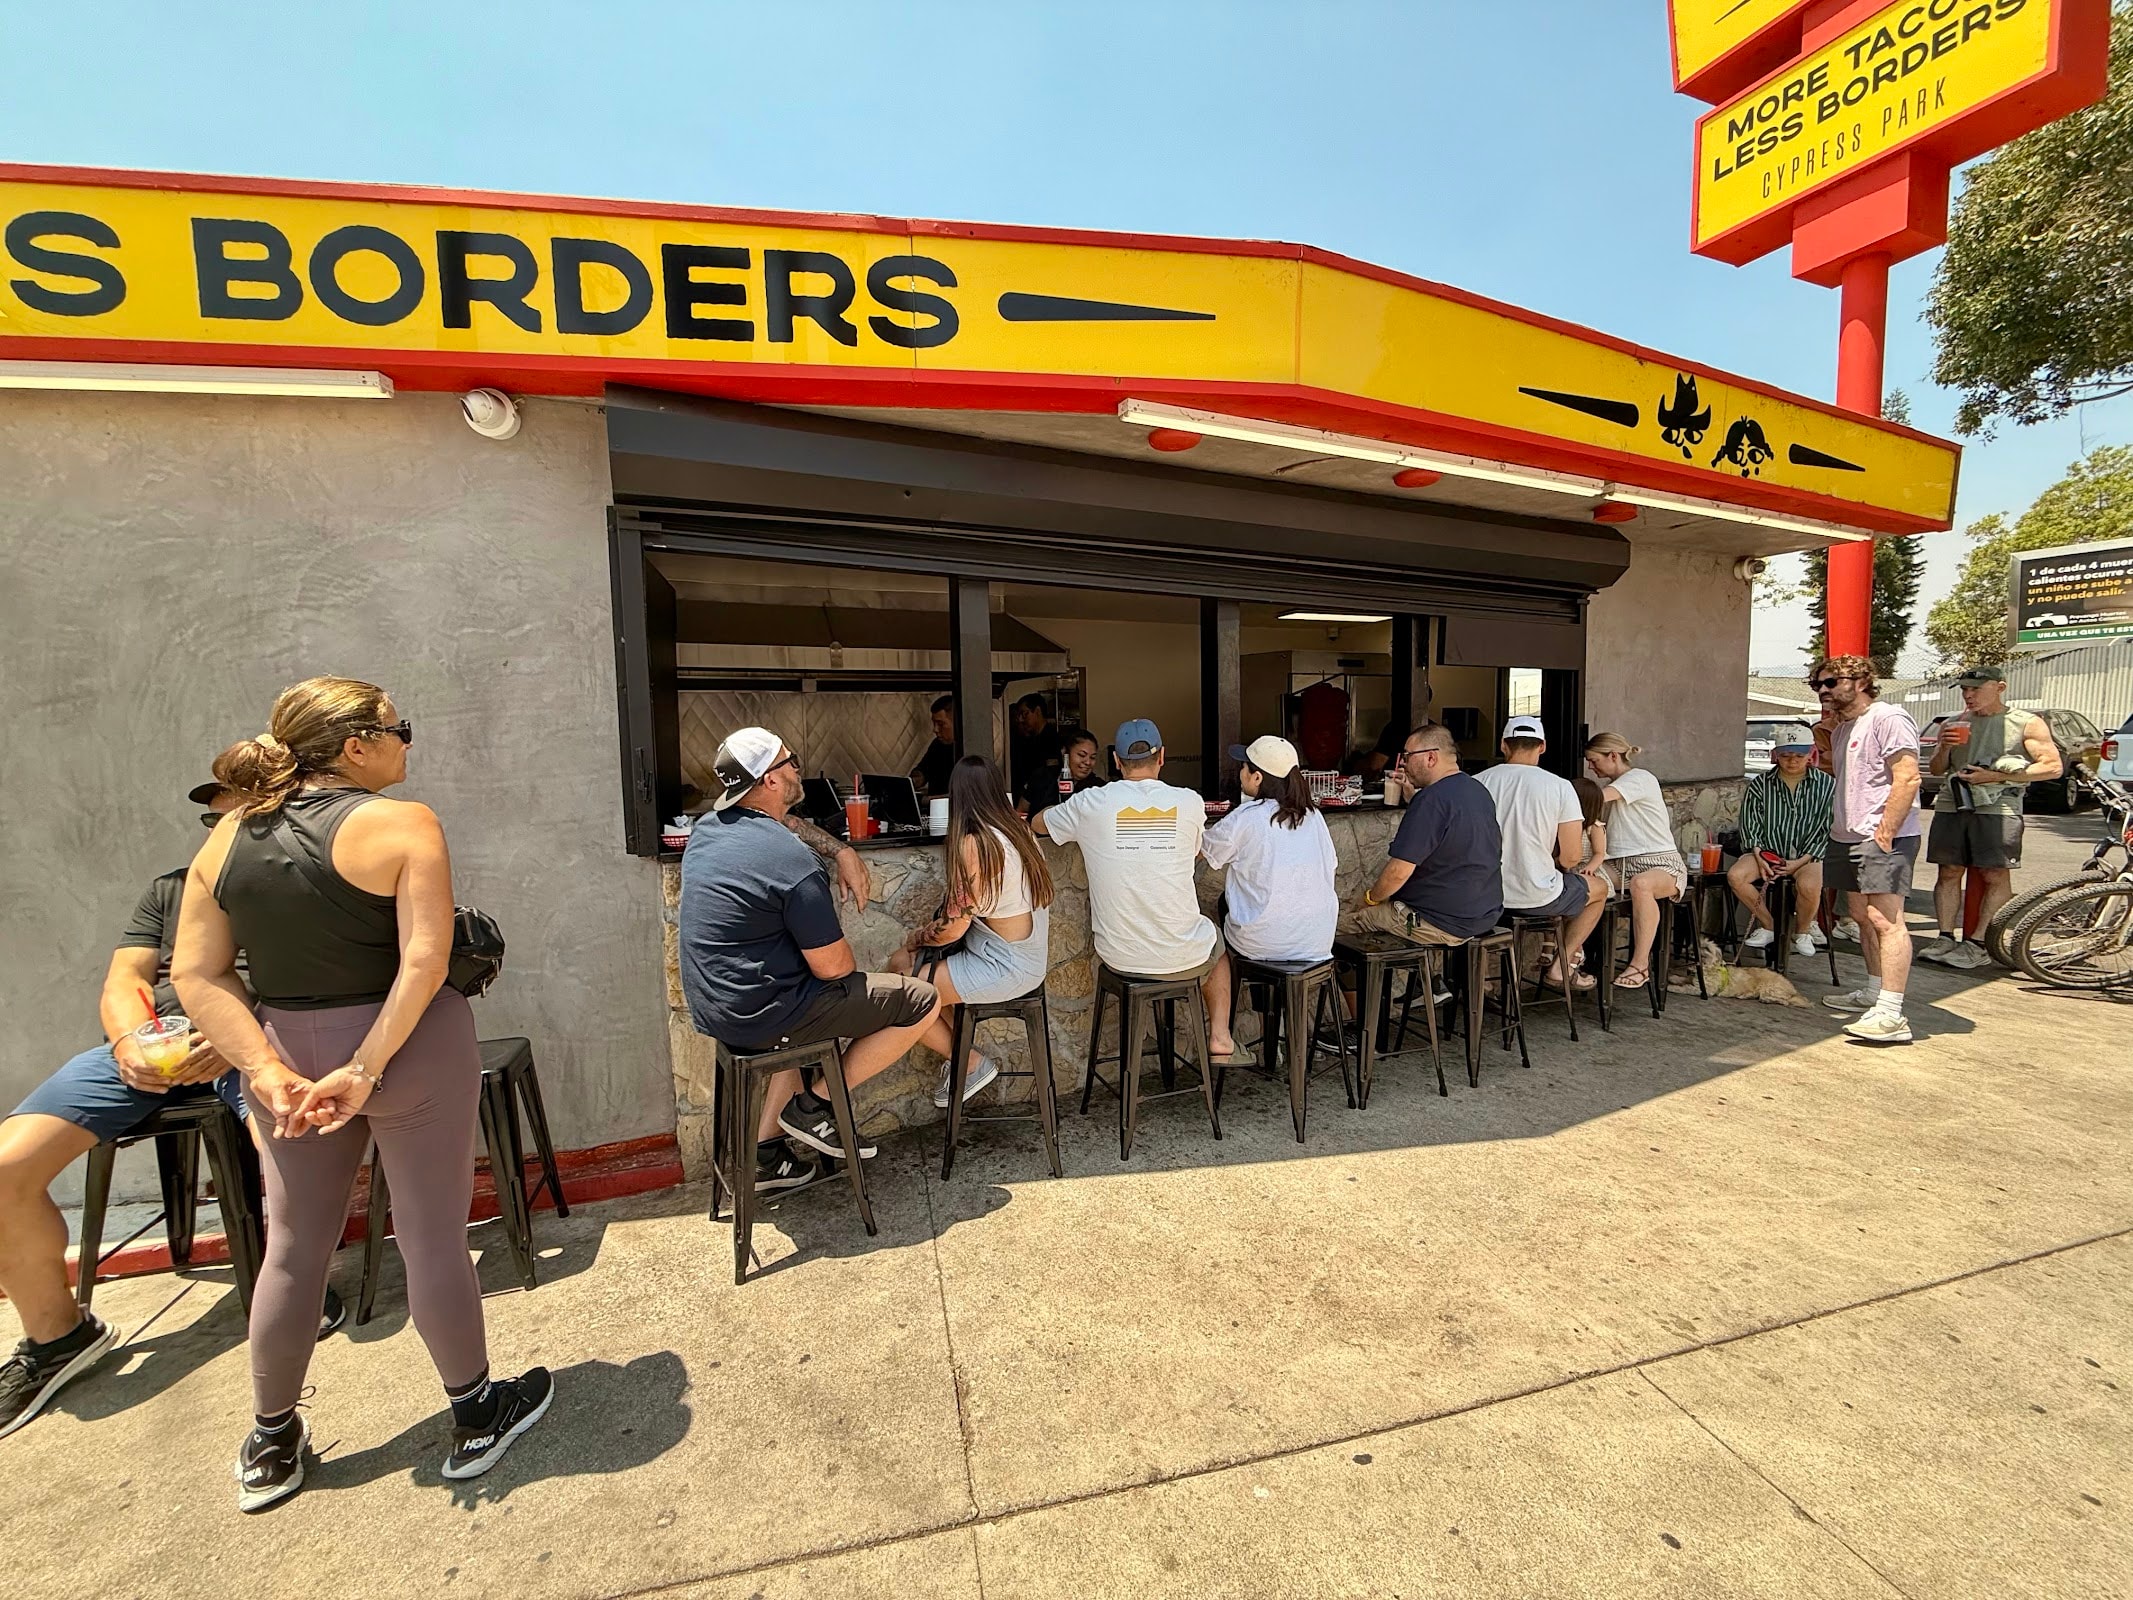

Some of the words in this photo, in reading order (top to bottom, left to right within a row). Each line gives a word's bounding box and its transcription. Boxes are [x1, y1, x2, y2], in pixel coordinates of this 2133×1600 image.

[1727, 61, 1830, 143] MORE
[1844, 0, 1974, 70] TACO
[1713, 112, 1804, 182] LESS
[1817, 0, 2028, 125] BORDERS
[1762, 123, 1862, 199] CYPRESS
[1882, 77, 1946, 137] PARK
[190, 217, 960, 349] BORDERS
[2028, 574, 2081, 586] calientes
[2083, 569, 2124, 580] ocurre
[2029, 568, 2036, 577] 1
[2039, 567, 2055, 576] de
[2057, 563, 2086, 573] cada
[2088, 561, 2098, 570] 4
[2028, 587, 2043, 595] un
[2045, 584, 2072, 593] niño
[2074, 582, 2088, 590] se
[2091, 579, 2121, 588] sube
[2027, 597, 2035, 606] y
[2037, 595, 2052, 603] no
[2055, 590, 2093, 603] puede
[2096, 587, 2126, 597] salir.
[2037, 631, 2058, 639] UNA
[2079, 628, 2101, 636] QUE
[811, 1120, 836, 1139] N
[777, 1160, 793, 1177] N
[463, 1433, 495, 1451] HOKA
[243, 1466, 263, 1483] OKA
